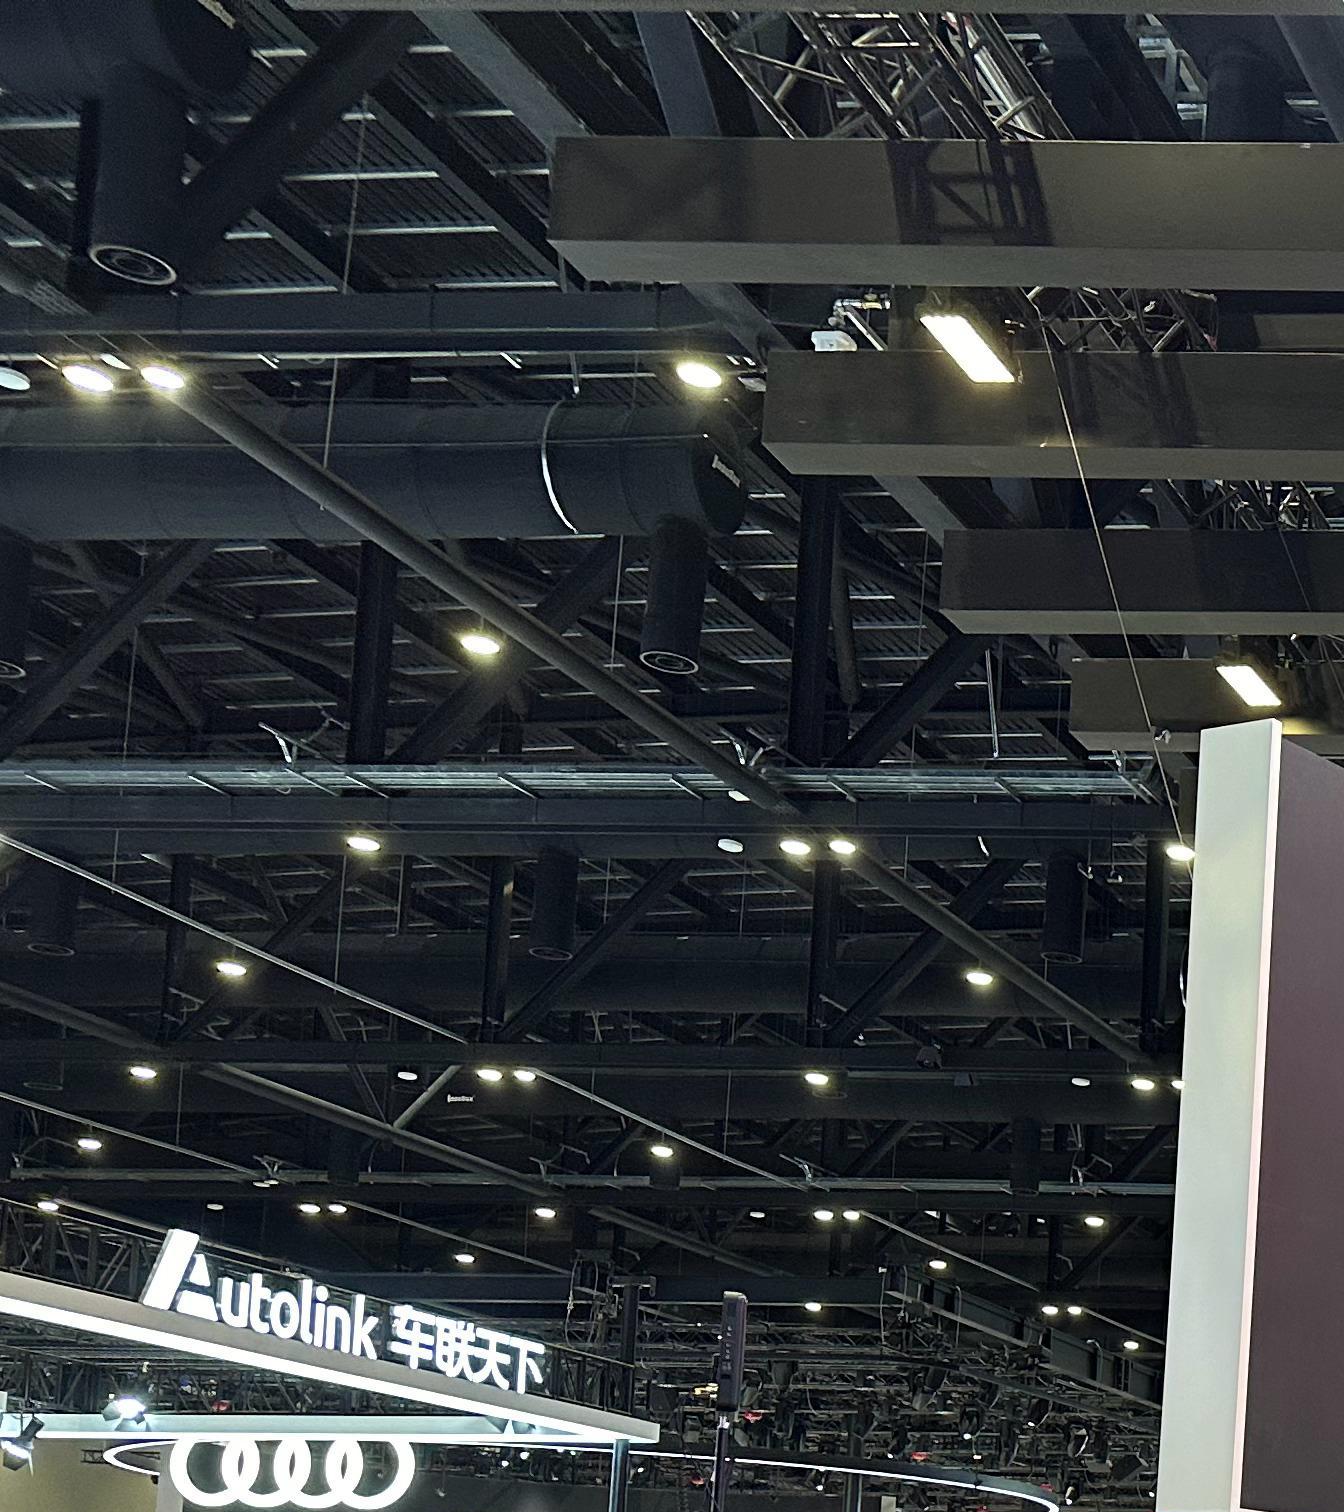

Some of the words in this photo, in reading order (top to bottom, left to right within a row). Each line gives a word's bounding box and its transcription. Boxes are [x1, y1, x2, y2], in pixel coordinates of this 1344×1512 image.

[142, 1229, 379, 1361] Autolink
[387, 1303, 547, 1395] 车联天下
